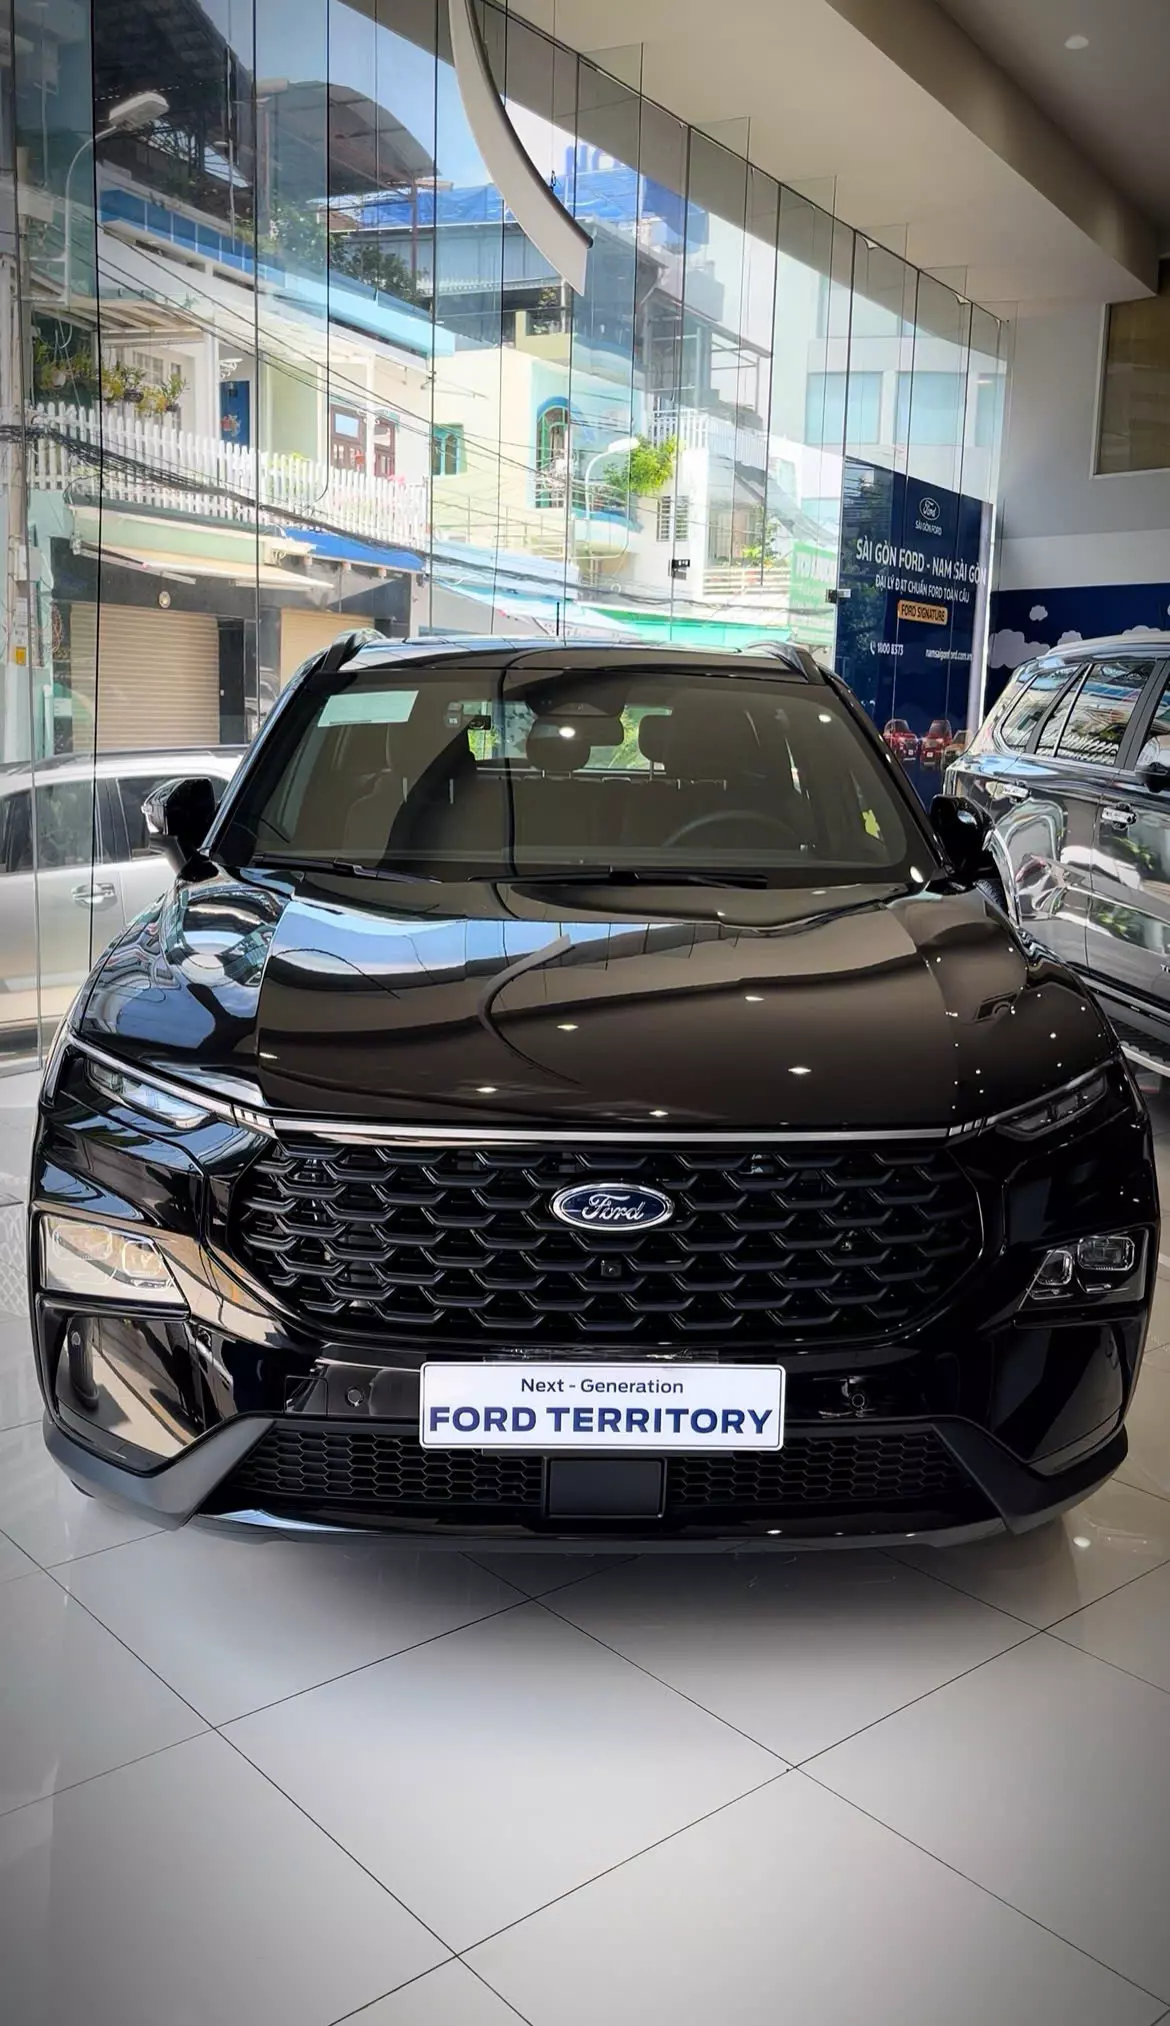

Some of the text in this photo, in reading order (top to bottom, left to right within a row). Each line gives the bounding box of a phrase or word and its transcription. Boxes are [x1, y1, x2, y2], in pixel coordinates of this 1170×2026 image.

[923, 500, 936, 517] Ford
[856, 535, 872, 562] SÀI
[875, 540, 897, 567] GÒN
[898, 548, 924, 572] FORD
[932, 556, 952, 579] NAM
[953, 558, 968, 582] SÀI
[968, 562, 986, 585] GÒN
[876, 574, 886, 592] ĐẠI
[888, 574, 894, 590] LÝ
[895, 577, 908, 595] ĐẠT
[928, 584, 942, 598] FORD
[902, 604, 945, 622] FORD SIGNATURE
[581, 1193, 645, 1220] Ford
[521, 1378, 564, 1393] Next
[580, 1378, 684, 1394] Generation
[429, 1406, 772, 1434] FORD TERRITORY
